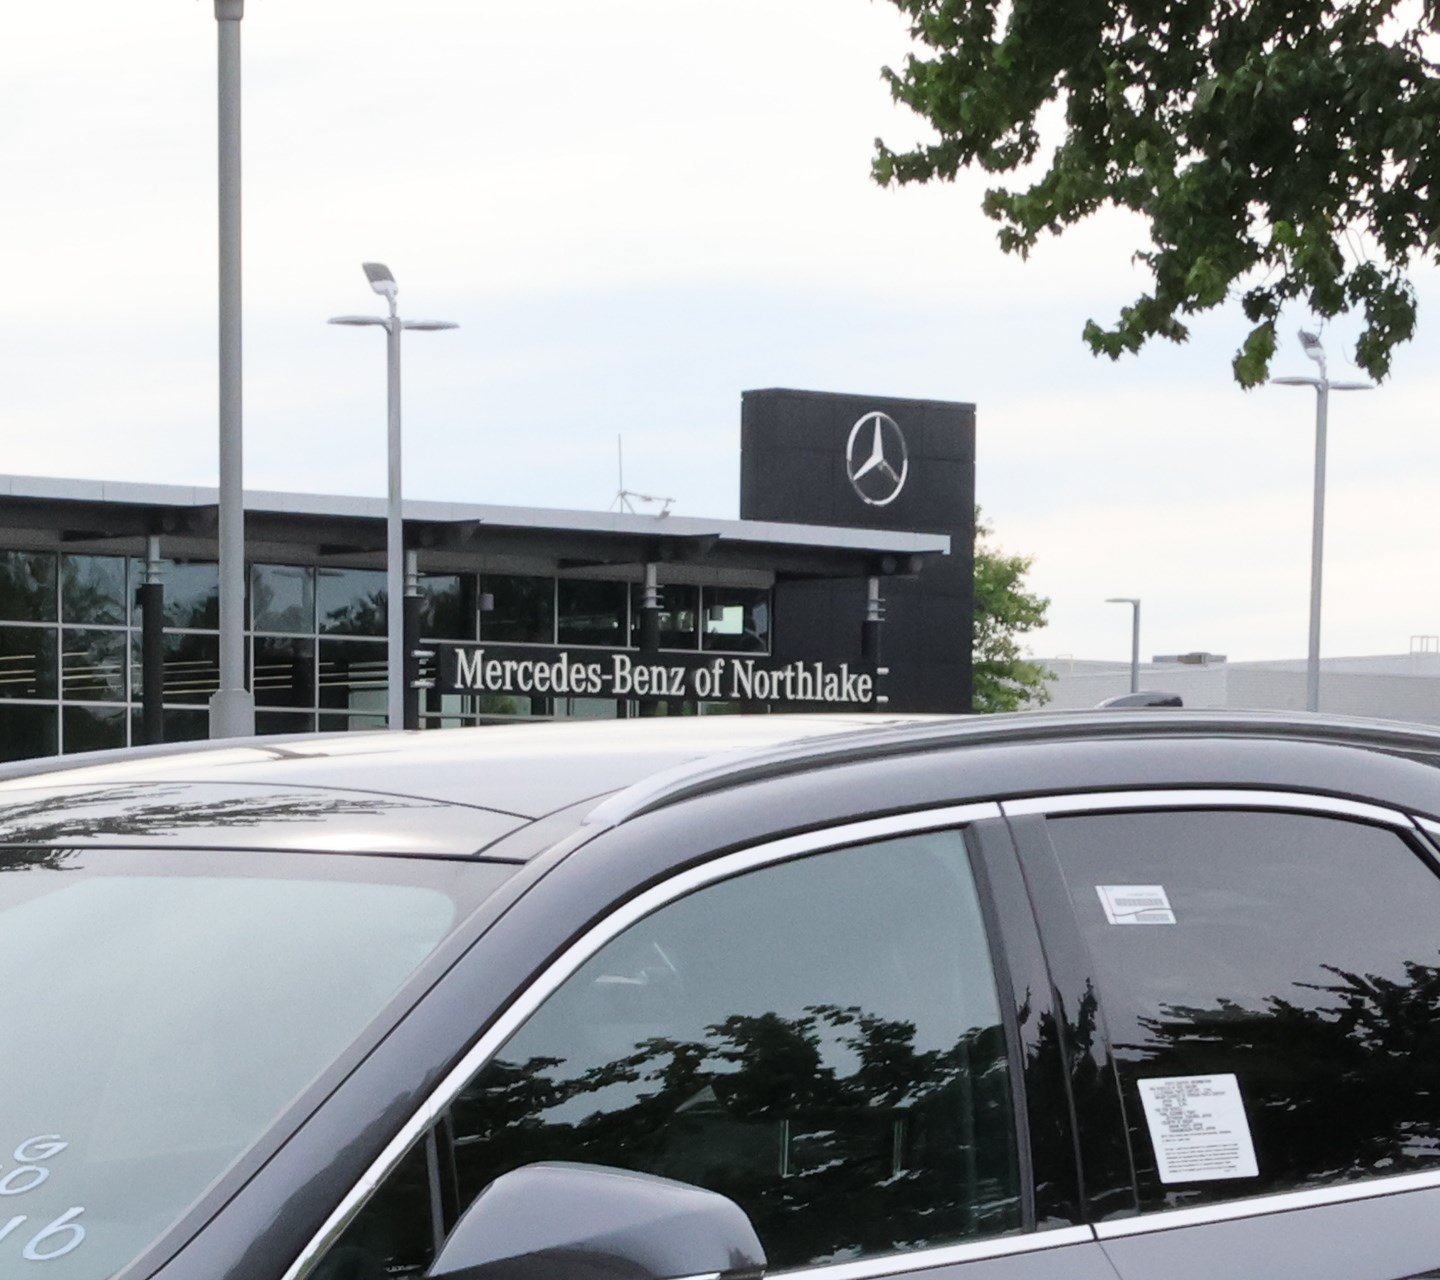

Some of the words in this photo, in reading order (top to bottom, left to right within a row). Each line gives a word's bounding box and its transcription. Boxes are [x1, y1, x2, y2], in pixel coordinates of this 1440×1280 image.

[454, 648, 686, 697] Mercedes-Benz
[695, 658, 723, 697] of
[732, 659, 873, 703] Northlake
